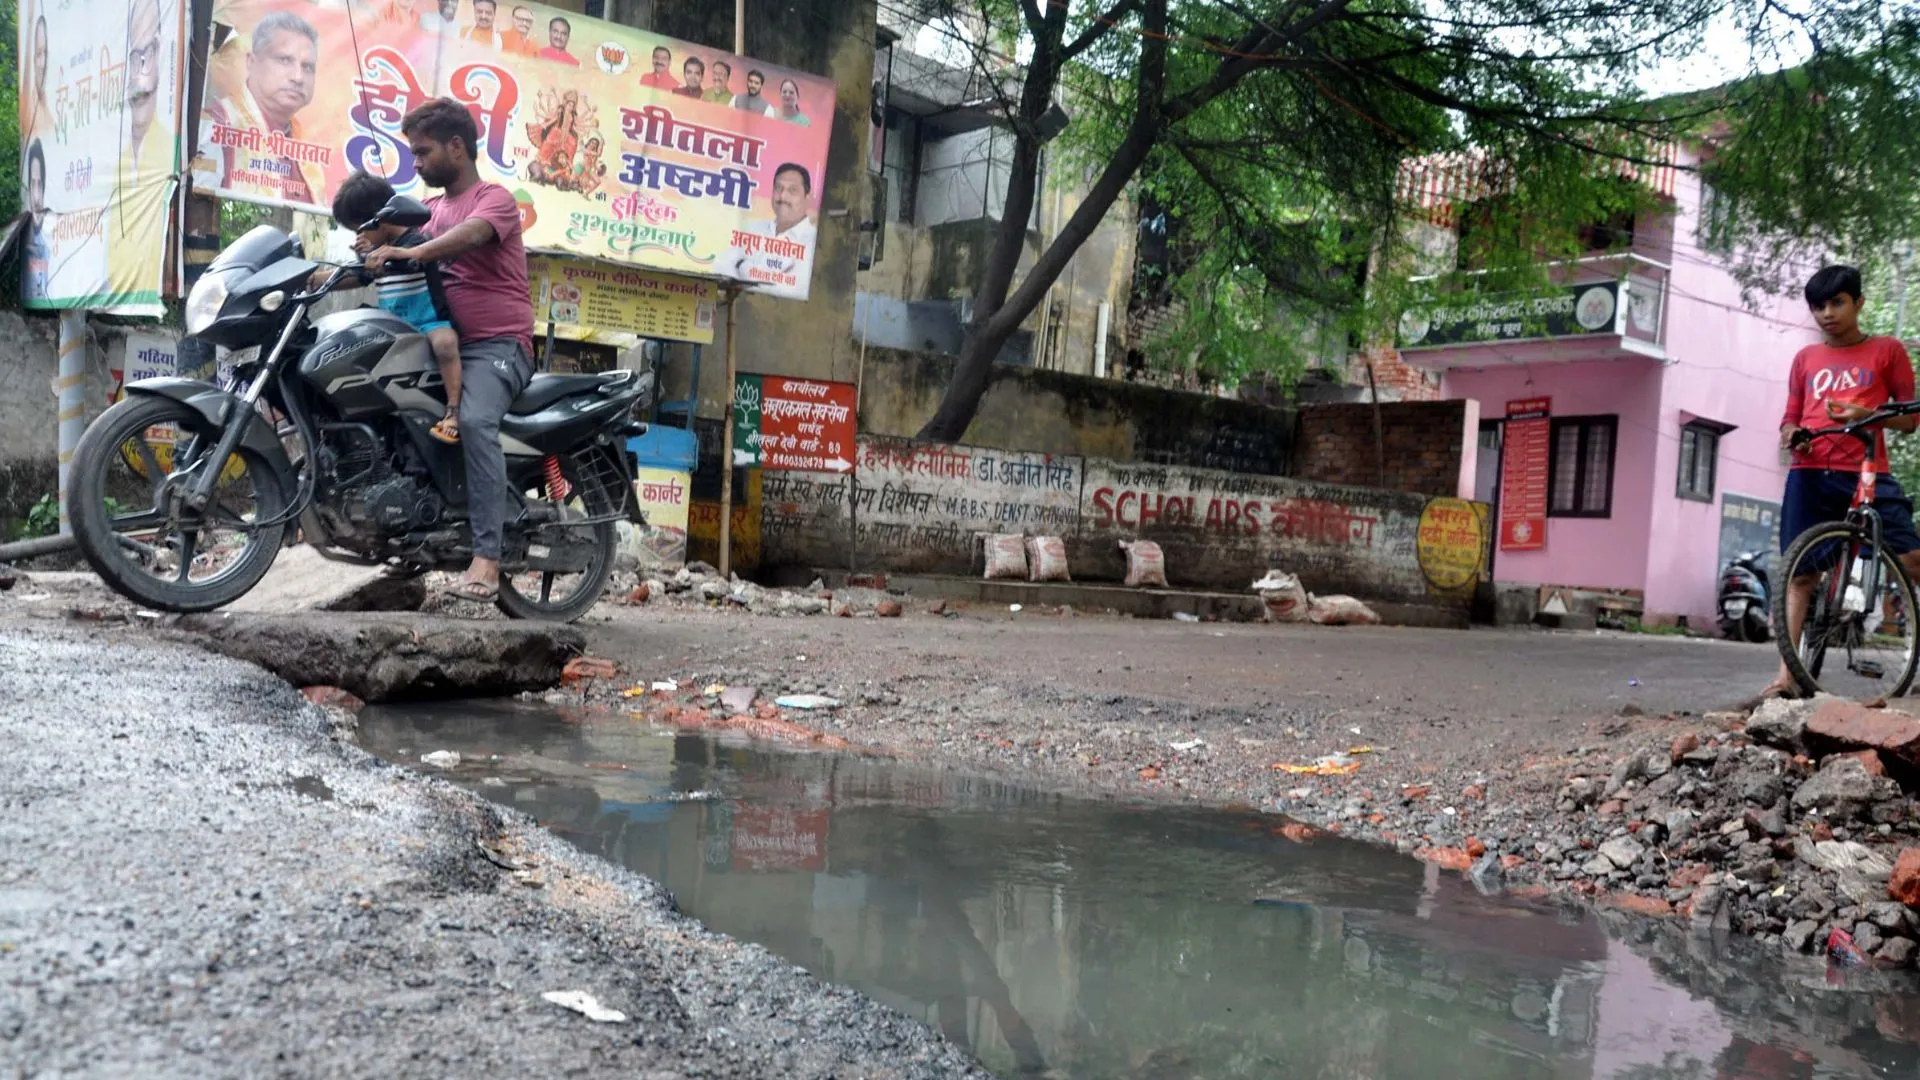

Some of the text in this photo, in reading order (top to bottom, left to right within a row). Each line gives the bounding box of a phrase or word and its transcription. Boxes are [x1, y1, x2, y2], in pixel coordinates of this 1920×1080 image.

[211, 121, 332, 165] अंजनी श्रीवास्तव
[619, 105, 766, 168] शीतला
[618, 153, 758, 210] अष्टमी
[611, 190, 678, 225] हार्दिक
[730, 230, 806, 260] अनूप सक्सेना
[782, 380, 829, 398] कार्यालय
[811, 400, 849, 424] सक्सेना
[745, 429, 779, 449] शीतला
[780, 432, 797, 452] देवी
[798, 422, 824, 437] पार्षद
[643, 478, 683, 504] कार्नर
[998, 456, 1043, 489] अजीत
[1045, 459, 1076, 495] सिंह
[1092, 487, 1262, 541] SCHOLARS
